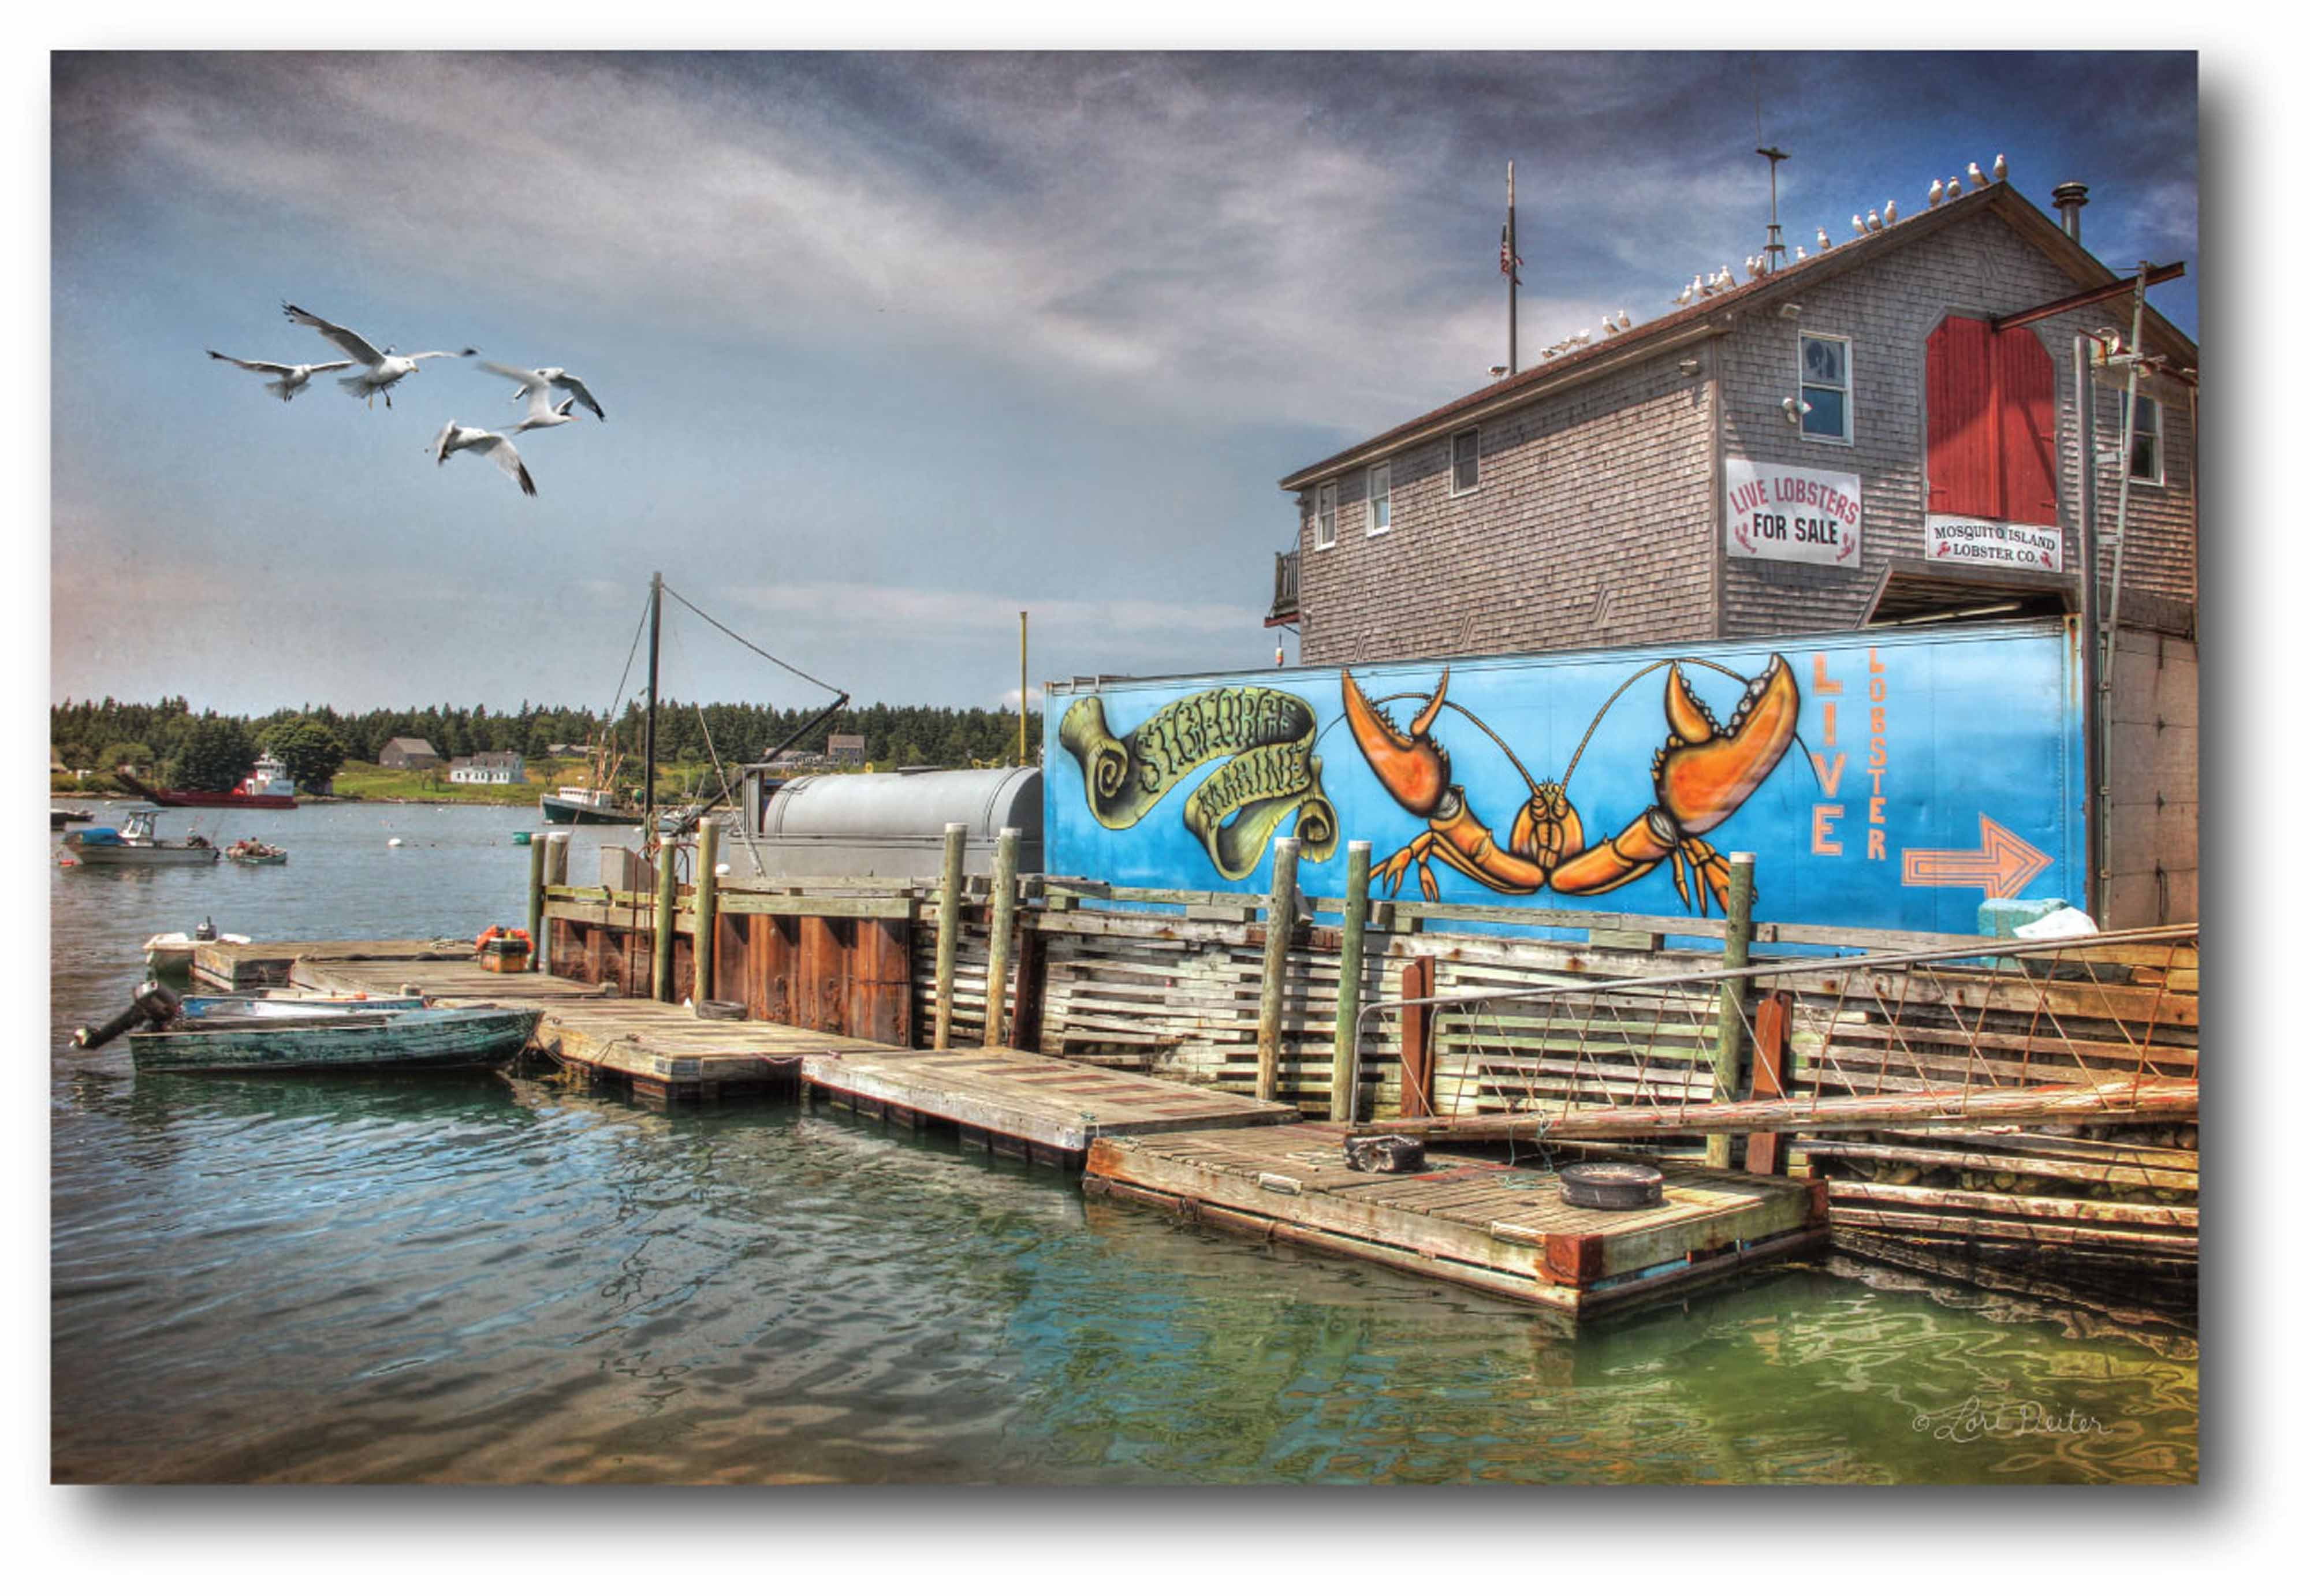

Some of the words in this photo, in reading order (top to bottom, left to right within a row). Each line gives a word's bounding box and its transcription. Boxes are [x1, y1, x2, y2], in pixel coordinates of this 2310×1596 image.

[1730, 479, 1769, 516] LIVE
[1774, 476, 1860, 525] LOBSTERS
[1753, 512, 1787, 541] FOR
[1794, 517, 1839, 545] SALE
[1934, 525, 2005, 540] MOSQUITO
[2008, 528, 2056, 551] ISLAND
[1953, 543, 2014, 561] LOBSTER
[2017, 550, 2040, 564] CO.
[1812, 652, 1846, 856] LIVE
[1866, 645, 1888, 861] LOBSTER
[1197, 744, 1306, 830] MARINE
